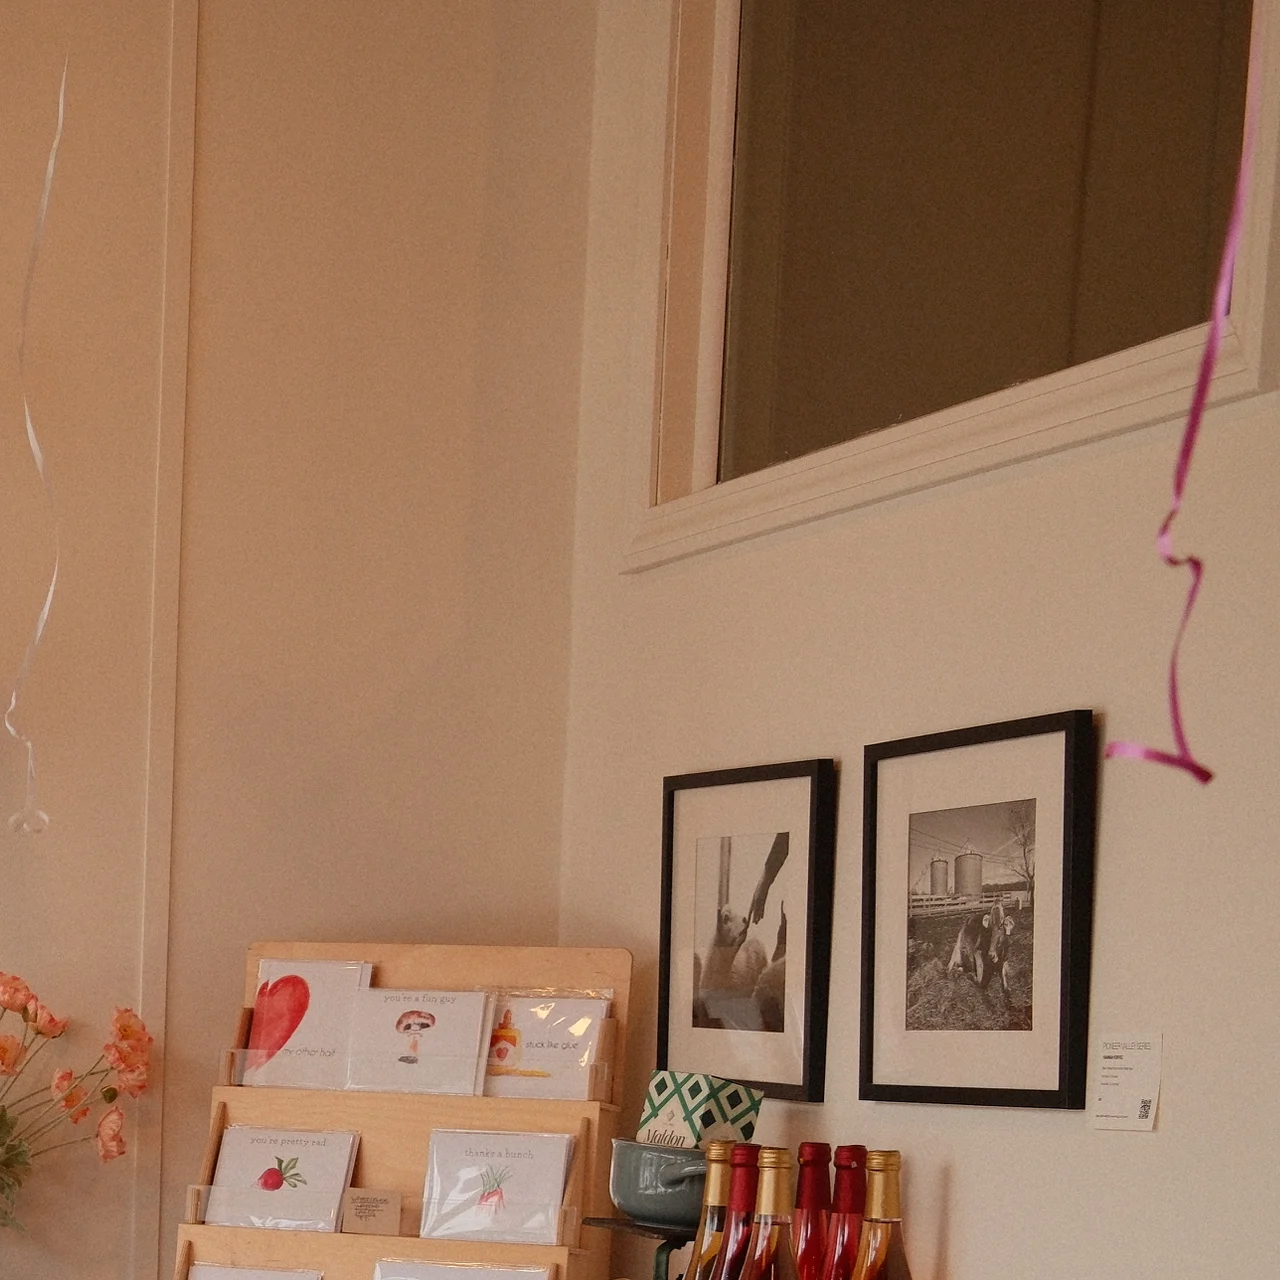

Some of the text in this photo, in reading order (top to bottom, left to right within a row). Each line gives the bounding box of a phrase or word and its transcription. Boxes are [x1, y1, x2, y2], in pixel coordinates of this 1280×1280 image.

[383, 994, 412, 1005] you're
[421, 994, 438, 1003] fun
[439, 995, 457, 1006] guy
[525, 1040, 545, 1049] stuck
[560, 1040, 579, 1051] glue
[249, 1136, 327, 1148] you're pretty rad
[643, 1129, 686, 1147] Maldon
[464, 1149, 494, 1159] thanks
[505, 1150, 534, 1160] bunch
